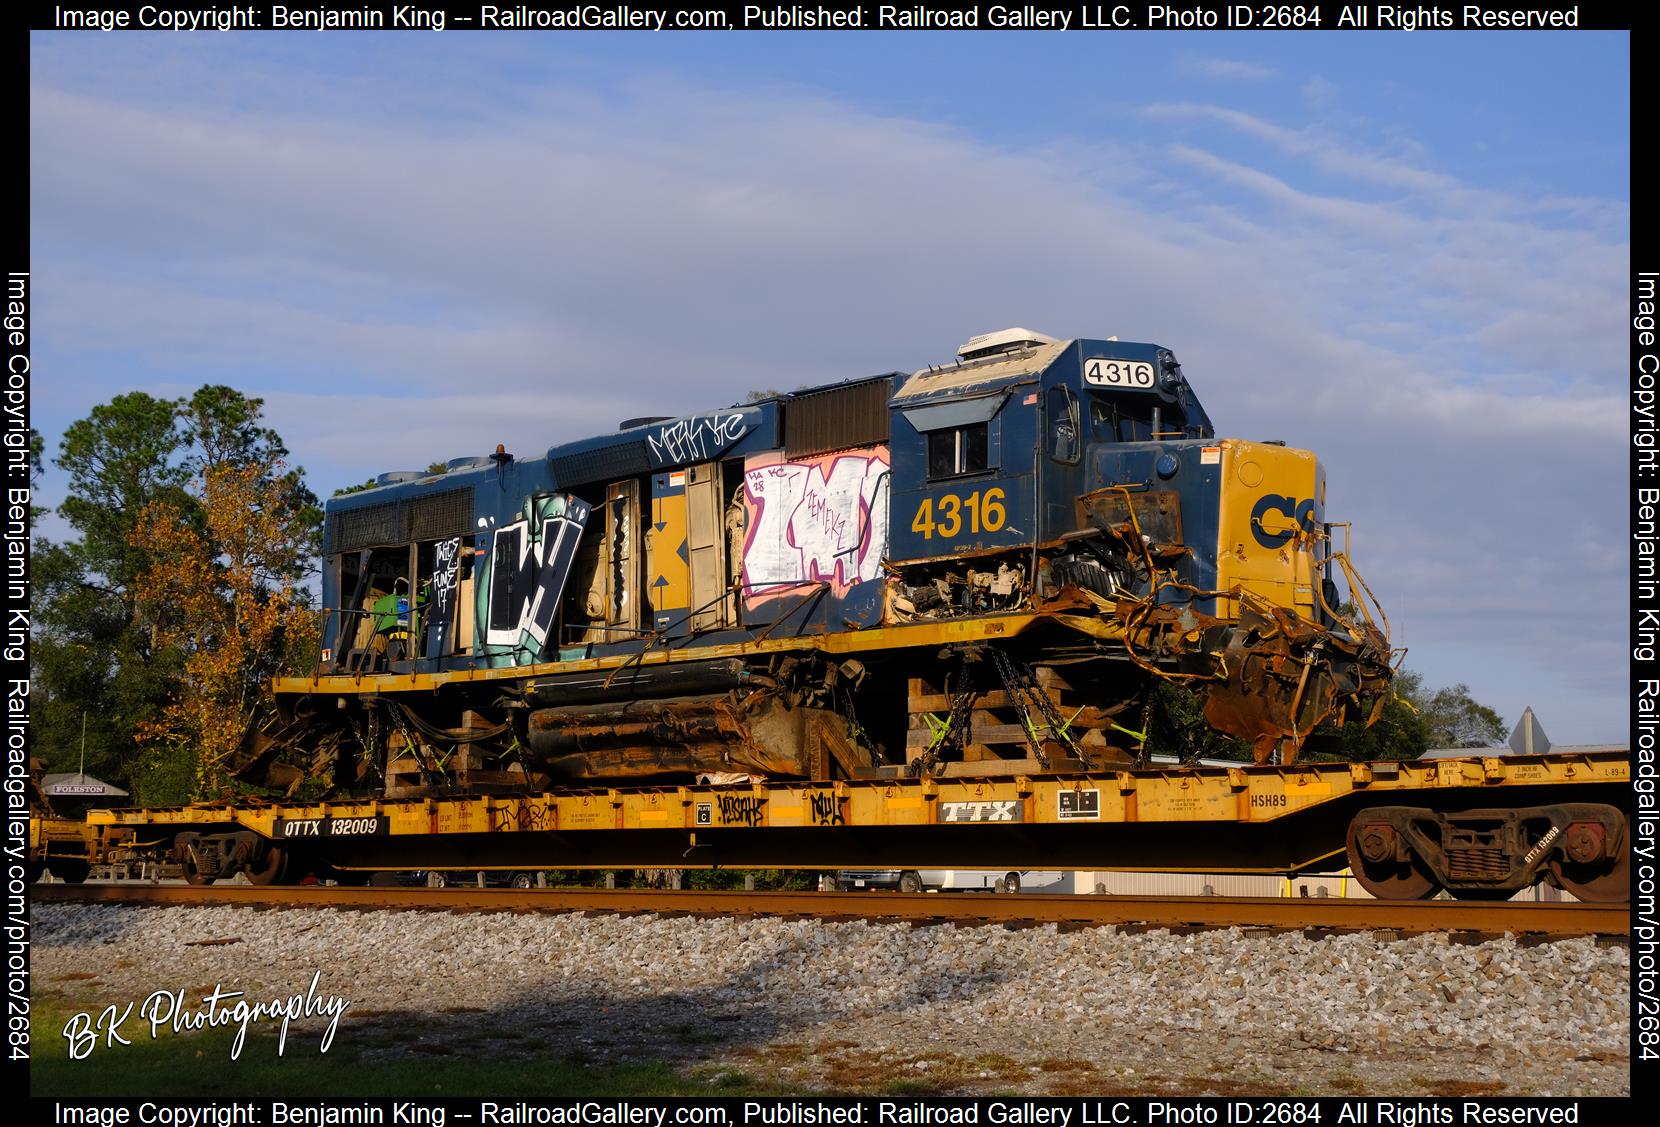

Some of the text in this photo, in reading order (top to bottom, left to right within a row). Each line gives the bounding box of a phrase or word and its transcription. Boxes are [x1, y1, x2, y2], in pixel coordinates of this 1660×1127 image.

[1088, 361, 1150, 386] 4316
[911, 487, 1006, 540] 4316
[1251, 794, 1287, 807] HSH89
[701, 813, 707, 822] C
[942, 801, 1017, 822] TTX
[330, 818, 378, 835] 132009
[1537, 826, 1560, 849] 132009
